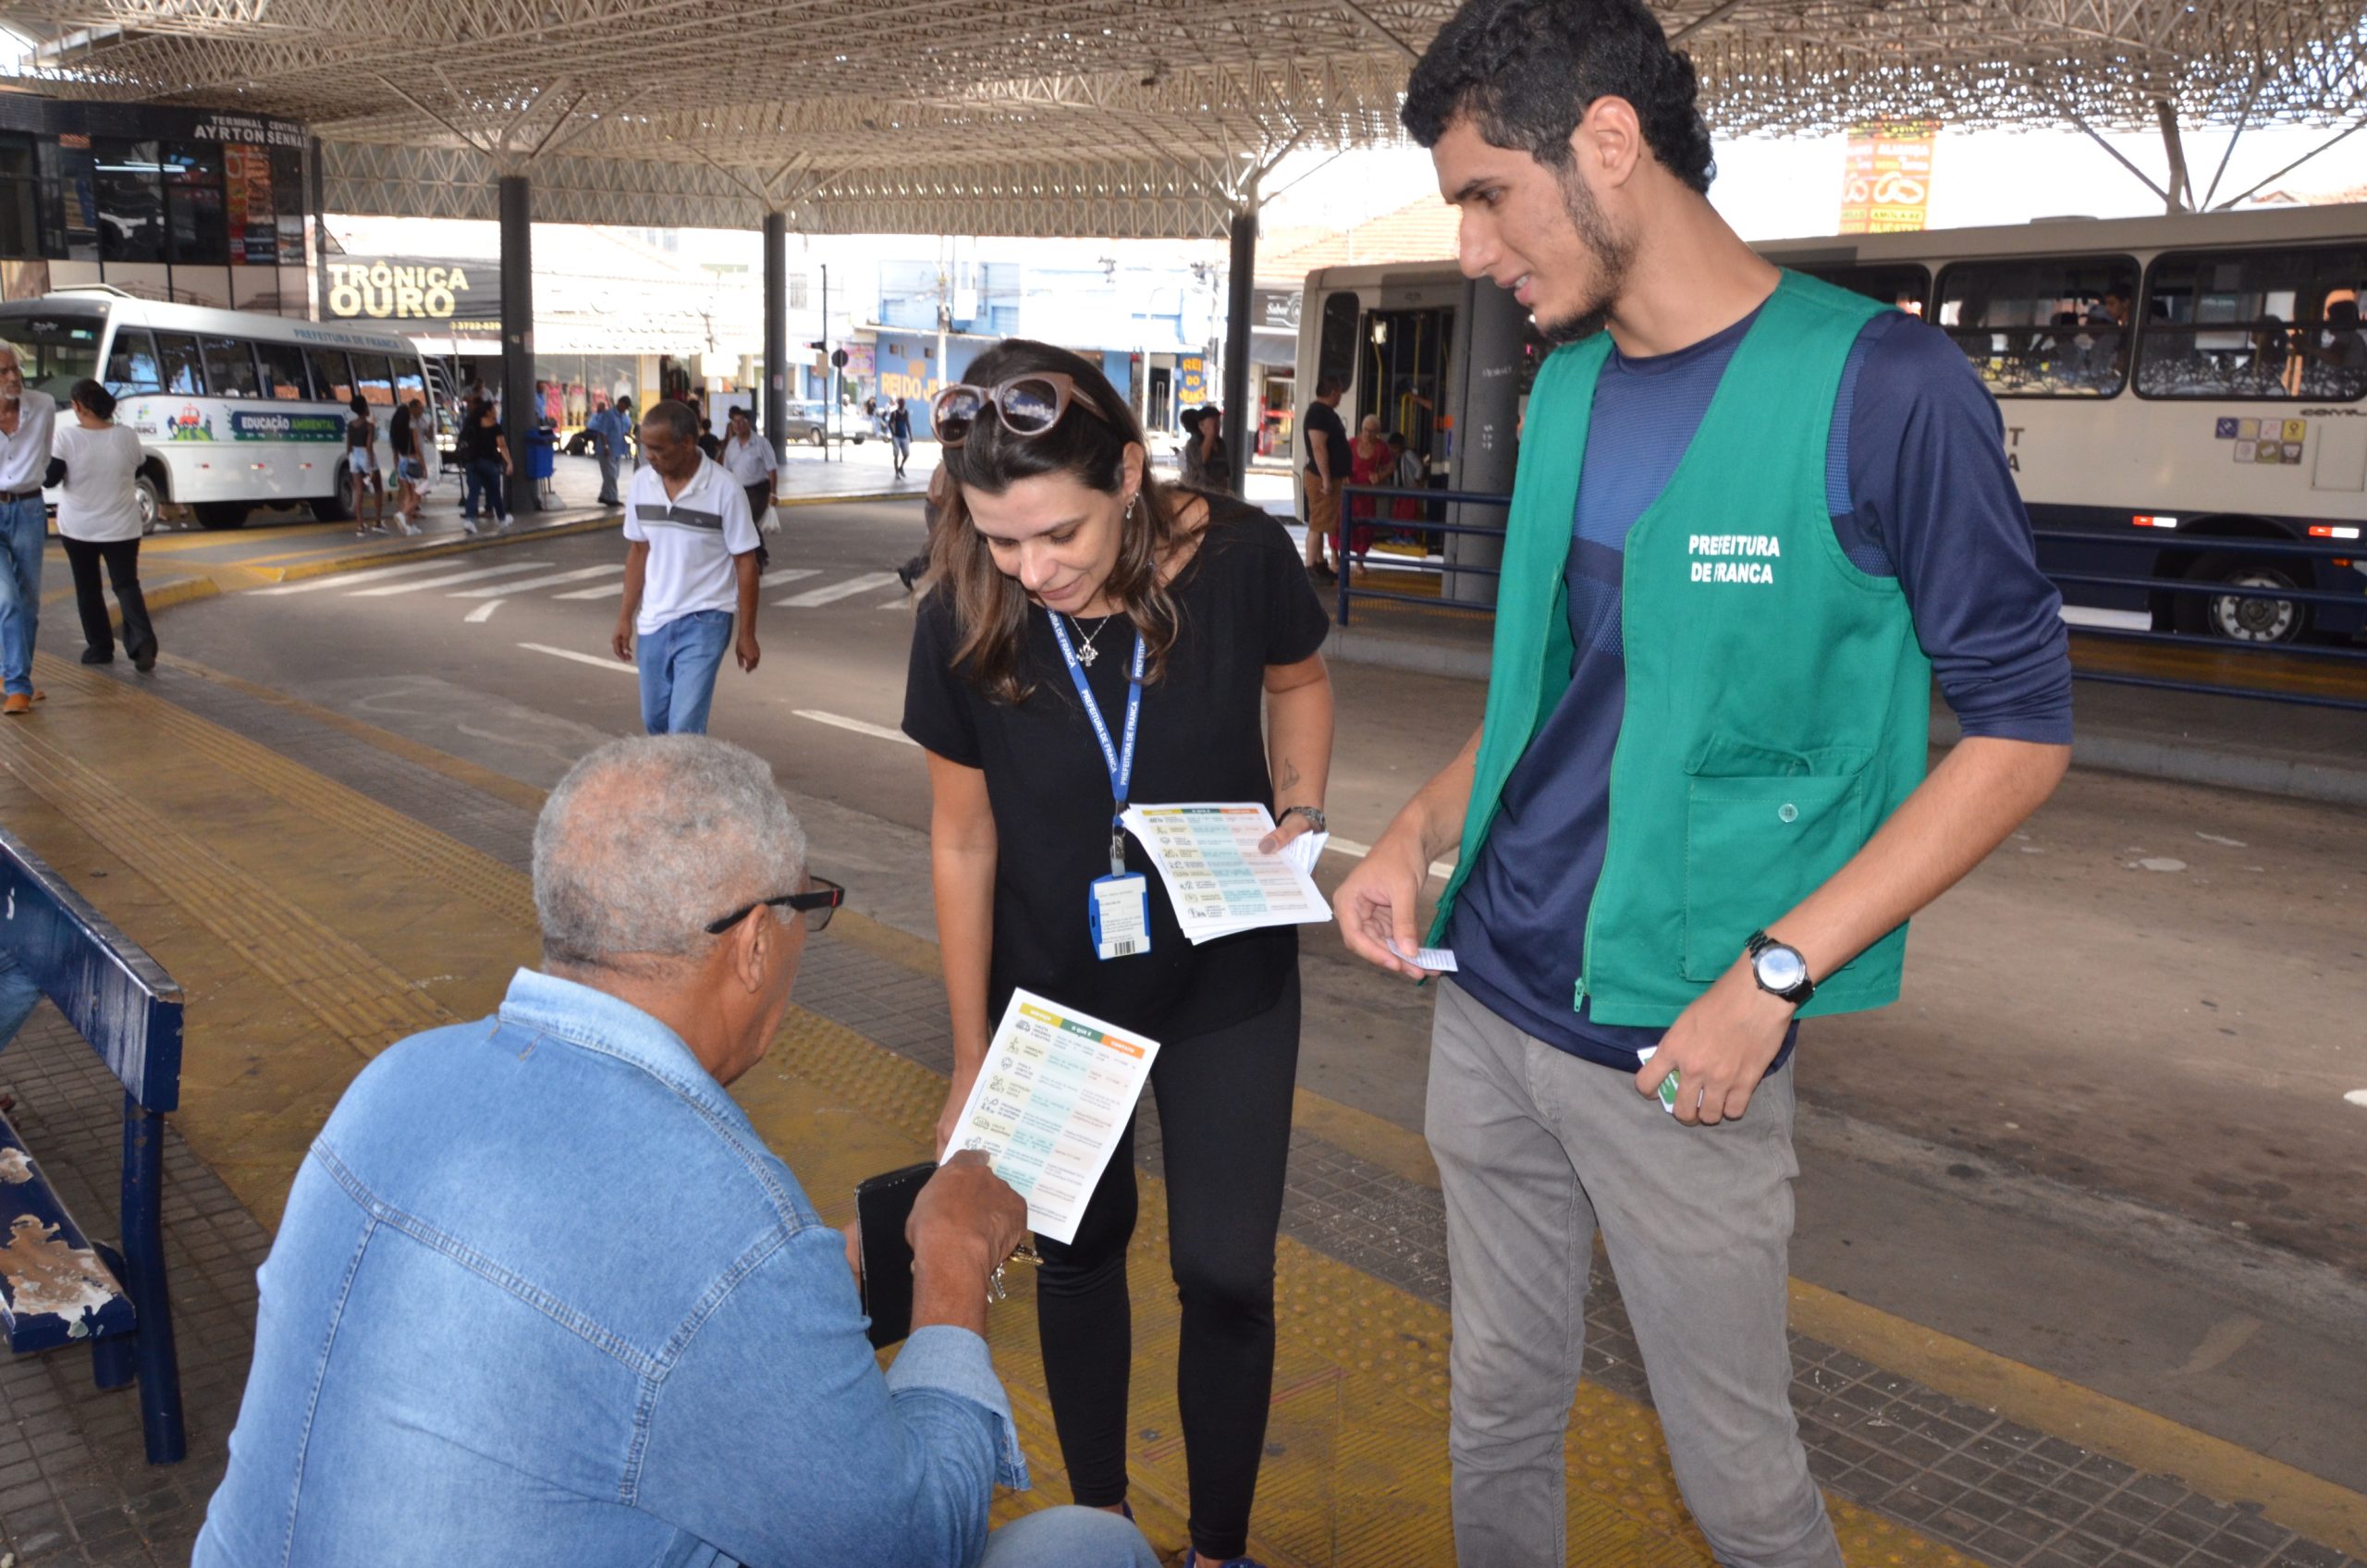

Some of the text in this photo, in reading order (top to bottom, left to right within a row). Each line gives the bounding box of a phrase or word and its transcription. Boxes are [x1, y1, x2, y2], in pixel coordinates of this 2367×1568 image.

[211, 116, 264, 129] TERMINAL
[194, 124, 302, 148] AYRTON SENNA
[326, 260, 470, 290] TRÔNICA
[329, 284, 456, 318] OURO
[293, 328, 350, 343] PREFEITURA
[1183, 358, 1202, 373] REI
[881, 372, 901, 398] REI
[901, 374, 922, 399] DO
[1185, 374, 1200, 386] DO
[241, 415, 337, 433] EDUCAÇÃO AMBIENTAL
[1688, 534, 1780, 557] PREFEITURA
[1691, 561, 1712, 582] DE
[1056, 628, 1064, 639] DE
[1060, 639, 1076, 668] FRANCA
[1082, 689, 1118, 774] PREFEITURA DE FRANCA
[1120, 742, 1134, 786] PREFEITURA
[1127, 701, 1138, 730] FRANCA
[1110, 1040, 1135, 1053] CONTATO
